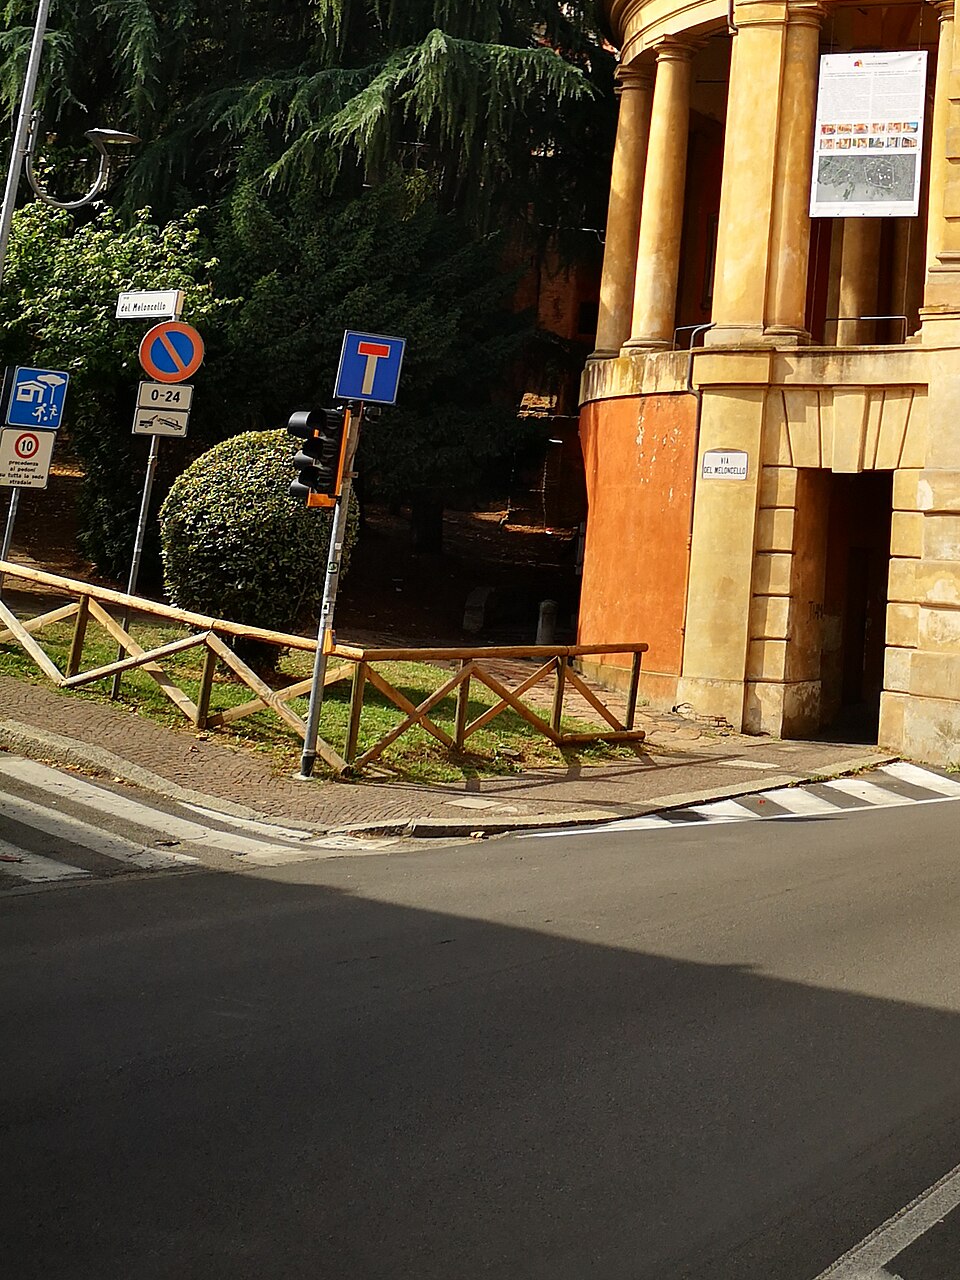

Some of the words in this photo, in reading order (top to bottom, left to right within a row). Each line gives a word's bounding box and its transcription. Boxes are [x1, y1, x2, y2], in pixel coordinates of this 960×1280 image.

[120, 303, 131, 312] del
[132, 301, 167, 312] Meloncello
[151, 389, 181, 403] 0-24
[21, 440, 33, 452] 10
[703, 466, 713, 474] DEL
[714, 466, 746, 475] MELONCELLO
